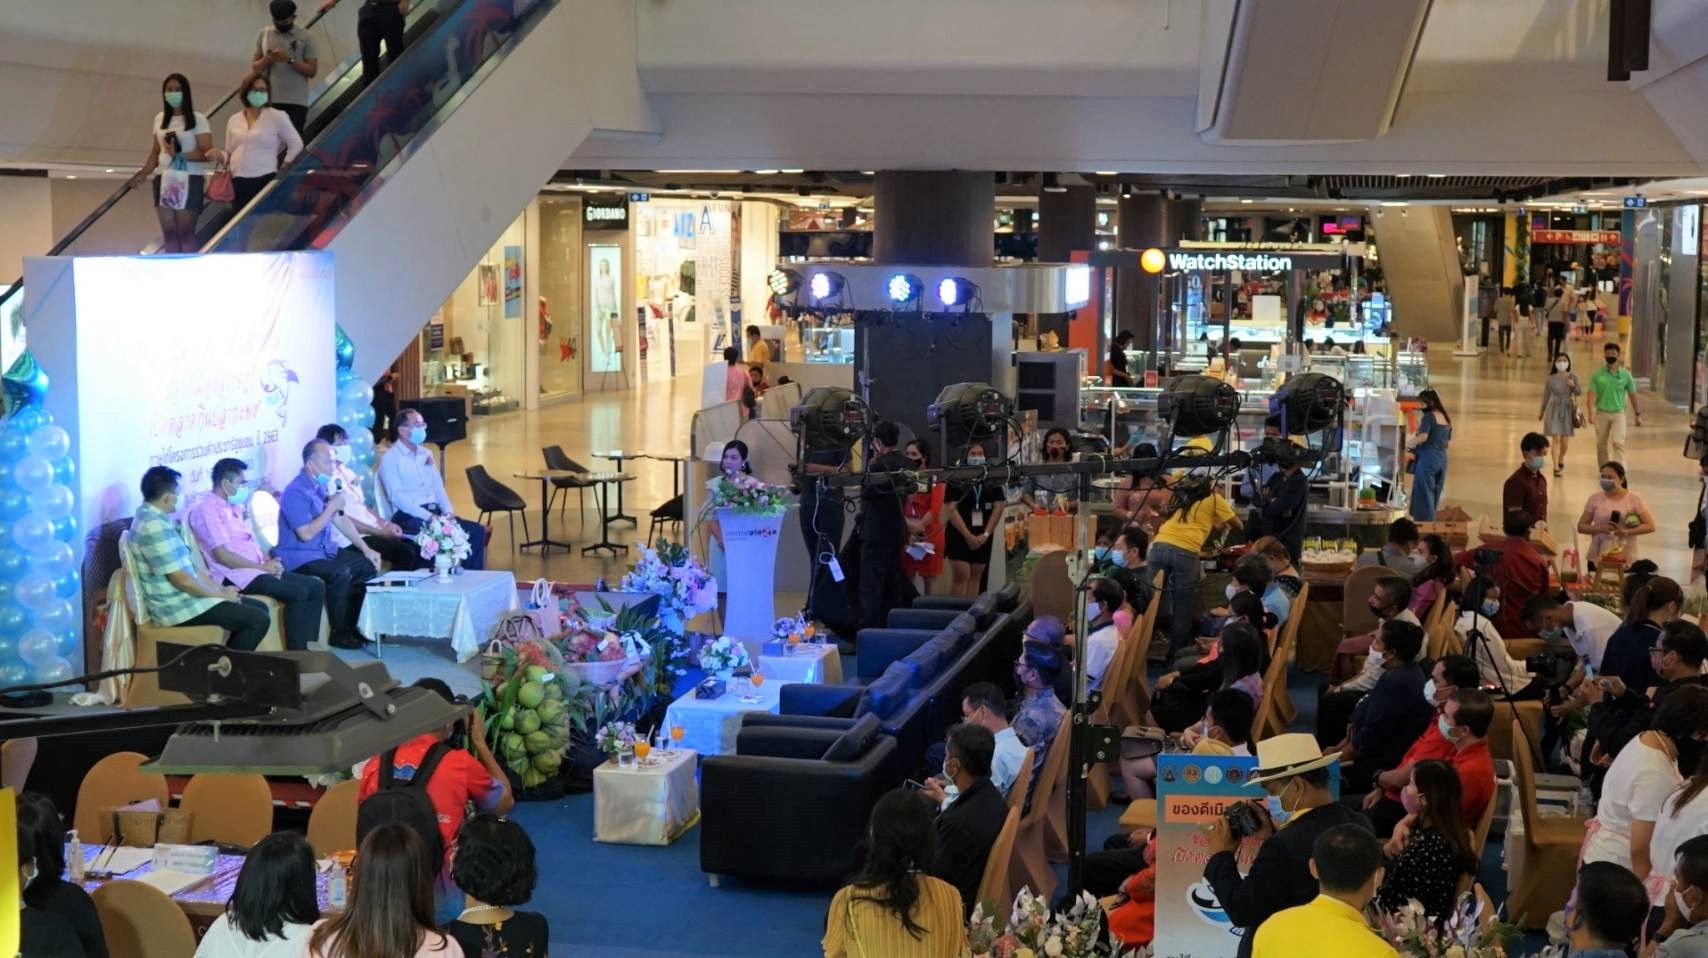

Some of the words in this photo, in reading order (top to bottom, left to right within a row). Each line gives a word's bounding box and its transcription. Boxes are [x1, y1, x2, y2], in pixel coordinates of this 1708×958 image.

[586, 206, 626, 221] GIORDANO
[1169, 253, 1292, 271] WatchStation
[263, 429, 279, 444] 2563
